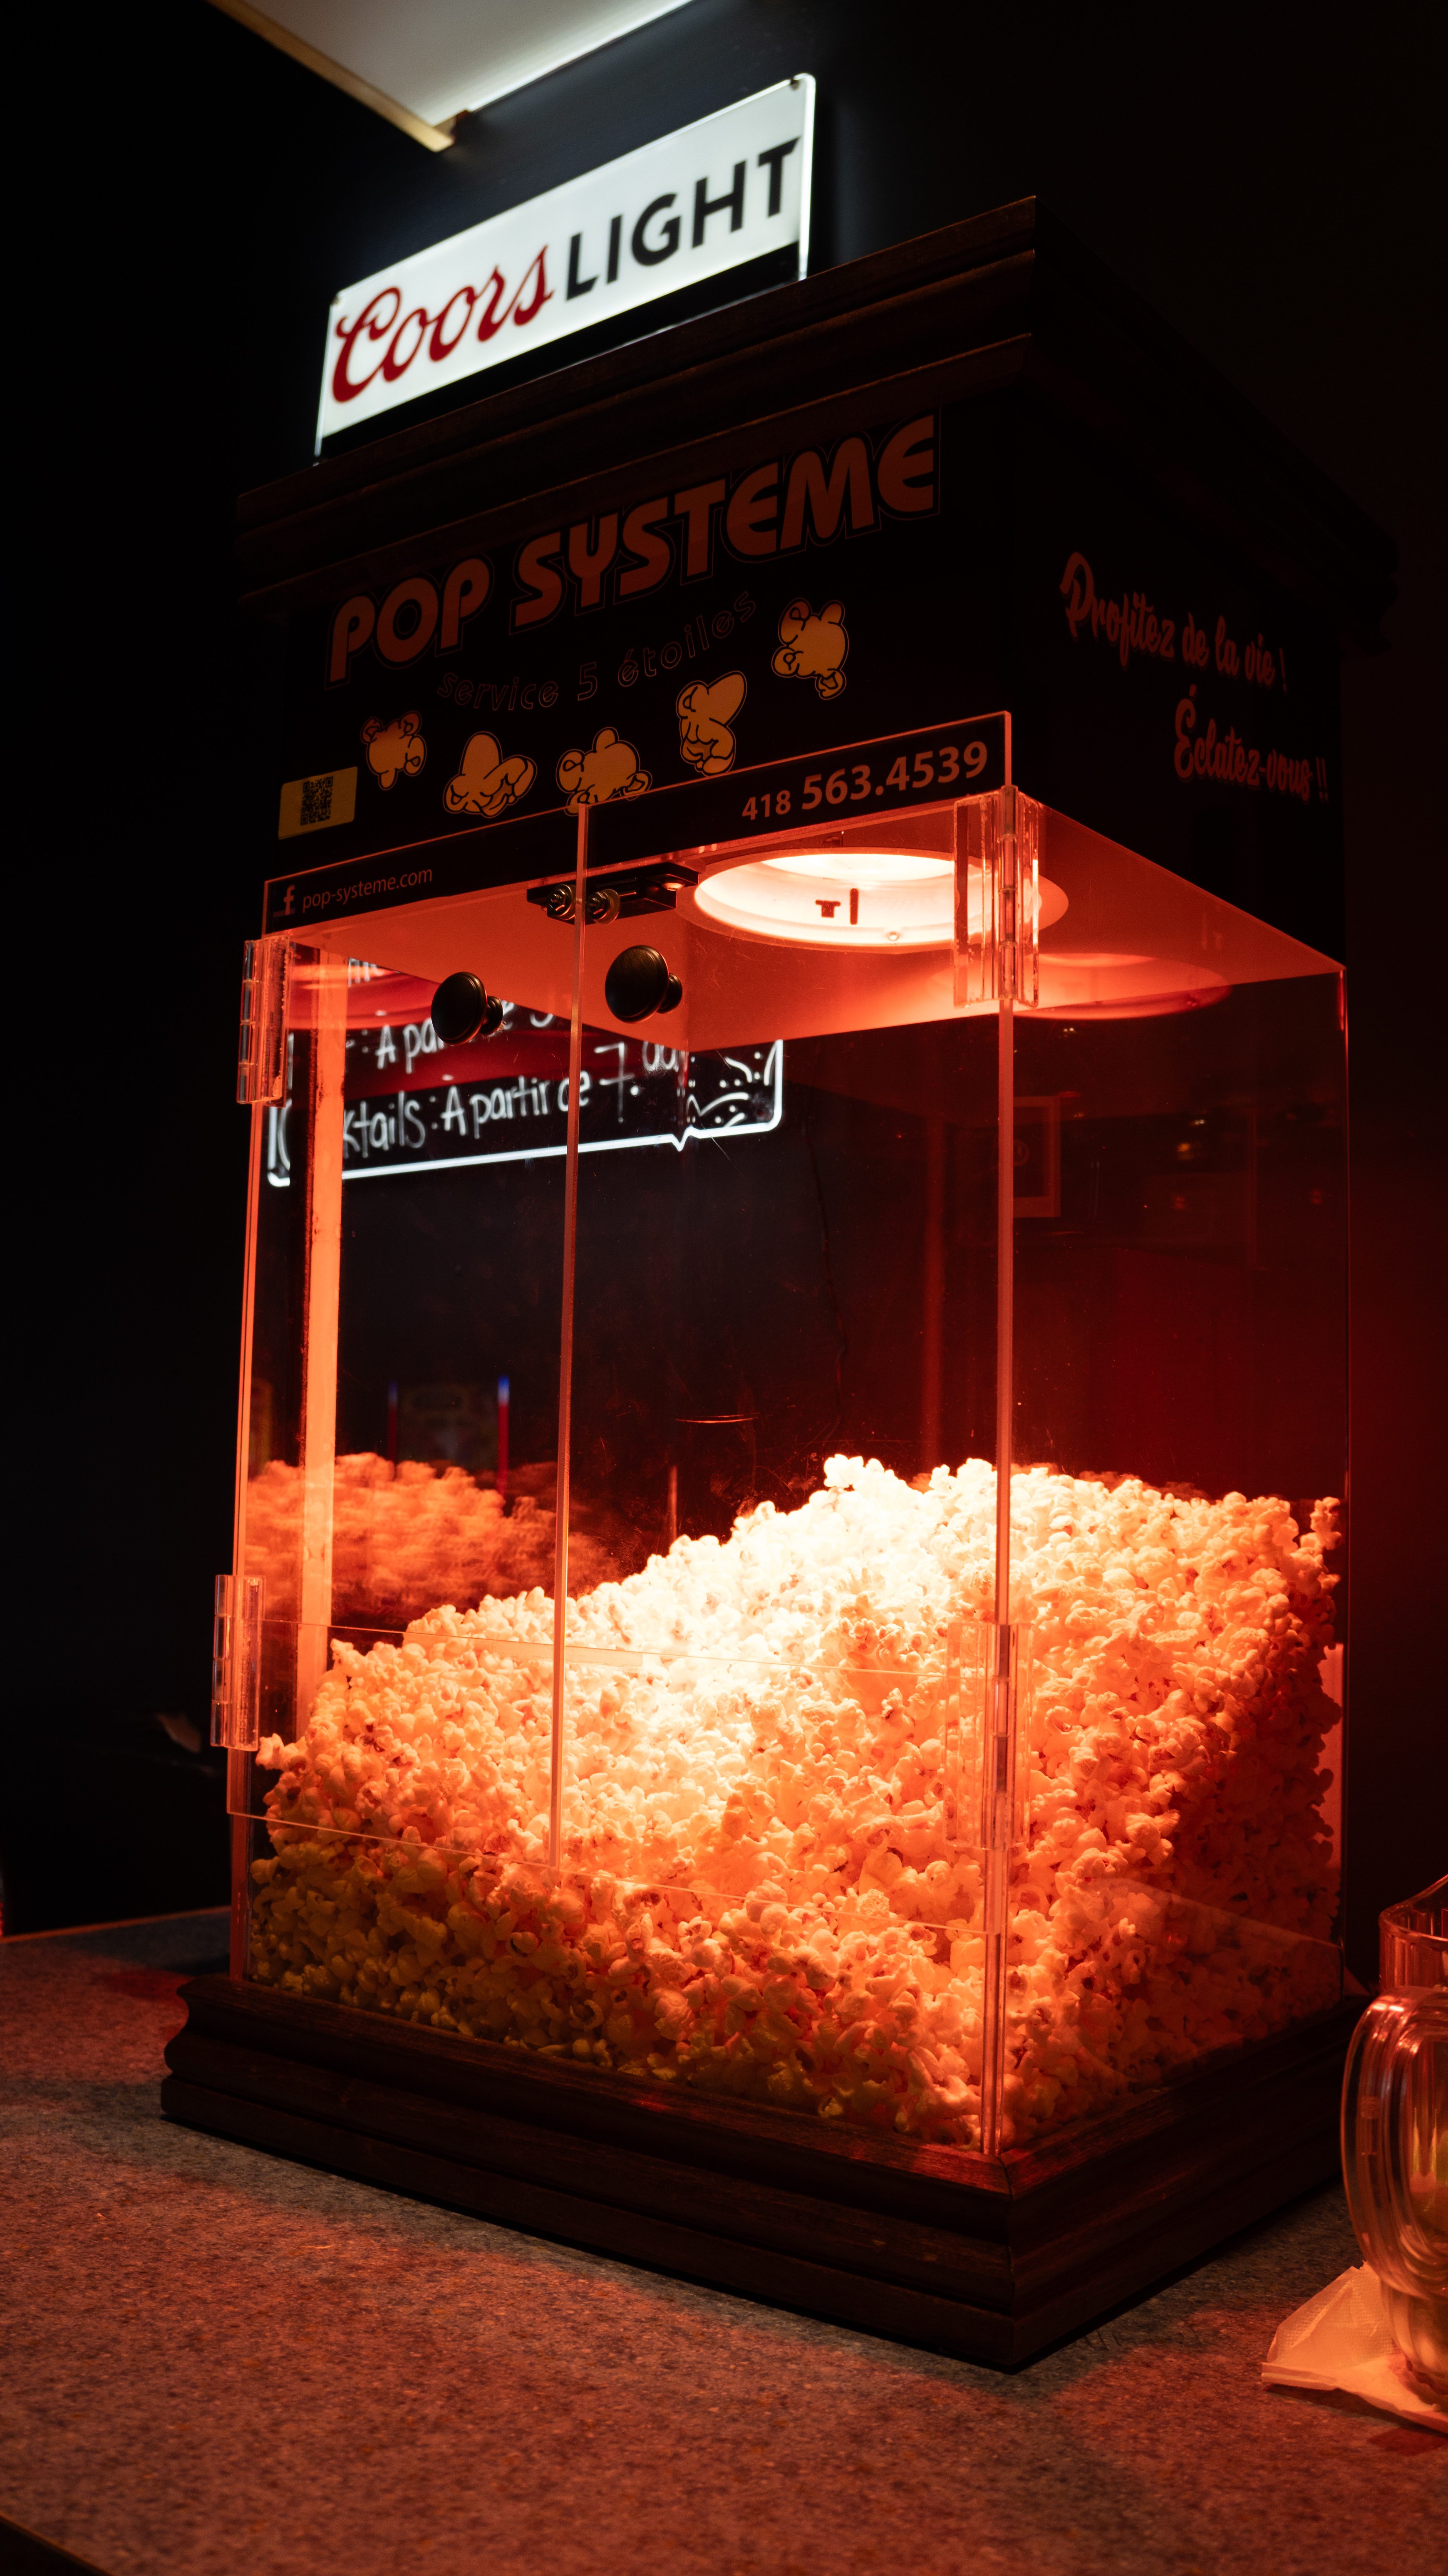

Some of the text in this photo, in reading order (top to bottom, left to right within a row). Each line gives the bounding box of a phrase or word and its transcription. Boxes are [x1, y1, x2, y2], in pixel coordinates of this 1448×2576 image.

[331, 136, 802, 404] Coors LIGHT
[326, 411, 938, 688] POP SYSTEME
[438, 591, 756, 711] service 5 étoiles
[1059, 551, 1175, 671] Profitez
[1182, 612, 1210, 671] de
[1215, 614, 1240, 681] la
[1244, 633, 1276, 689] vie
[742, 741, 987, 820] 418 563.4539
[1175, 684, 1314, 805] Éclatez-vous
[302, 869, 433, 913] pop-systeme.com
[470, 1075, 551, 1139] partir
